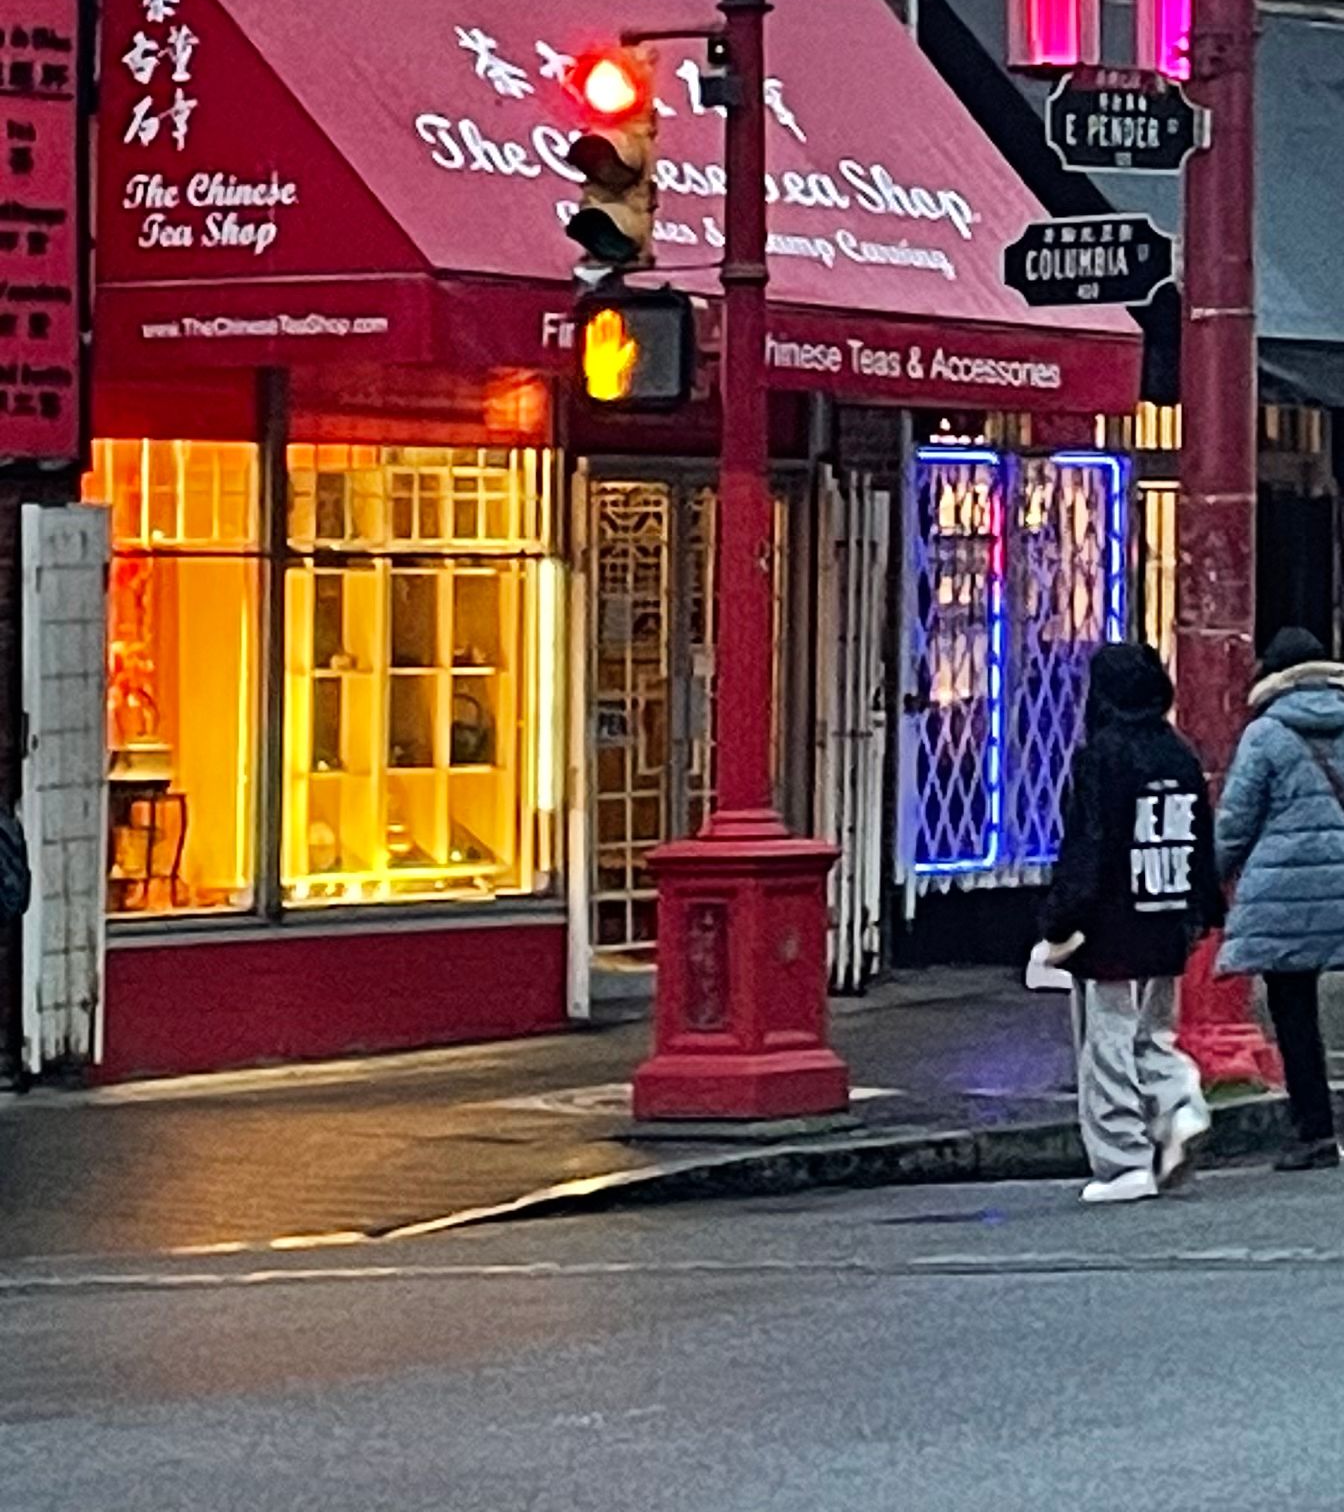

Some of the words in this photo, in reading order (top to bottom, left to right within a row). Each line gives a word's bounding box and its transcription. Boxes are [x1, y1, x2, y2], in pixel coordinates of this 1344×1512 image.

[1088, 114, 1161, 148] PENDER
[122, 173, 180, 209] The
[186, 172, 297, 208] Chinese
[415, 113, 542, 179] The
[838, 159, 974, 240] Shop
[138, 213, 193, 247] Tea
[201, 212, 278, 255] Shop
[1025, 246, 1130, 281] COLUMBIA
[763, 331, 843, 373] hinese
[846, 339, 901, 379] Teas
[906, 346, 925, 380] &
[929, 347, 1062, 389] Accessories
